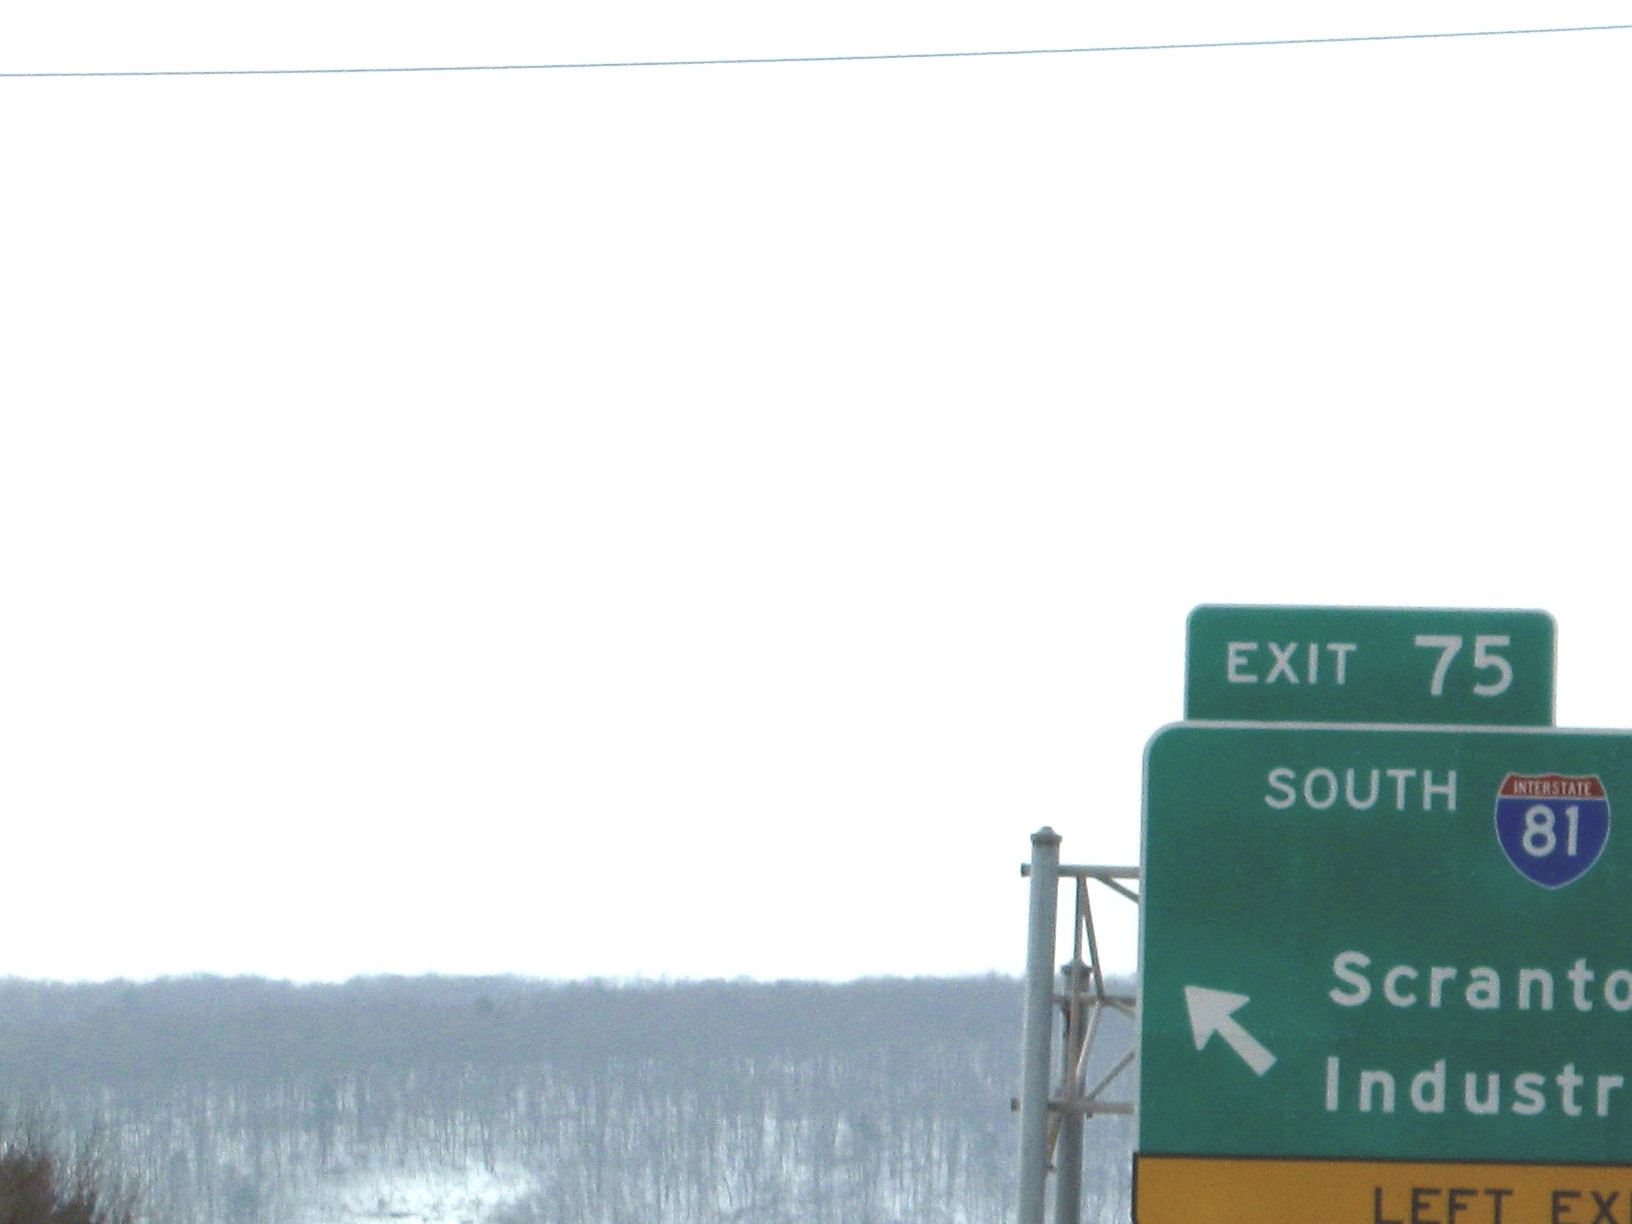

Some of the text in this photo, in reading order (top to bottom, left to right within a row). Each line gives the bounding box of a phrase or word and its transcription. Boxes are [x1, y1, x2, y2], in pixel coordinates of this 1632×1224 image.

[1225, 634, 1514, 698] EXIT 75
[1265, 767, 1458, 812] SOUTH
[1513, 780, 1593, 797] INTERSTATE
[1522, 804, 1579, 857] 81
